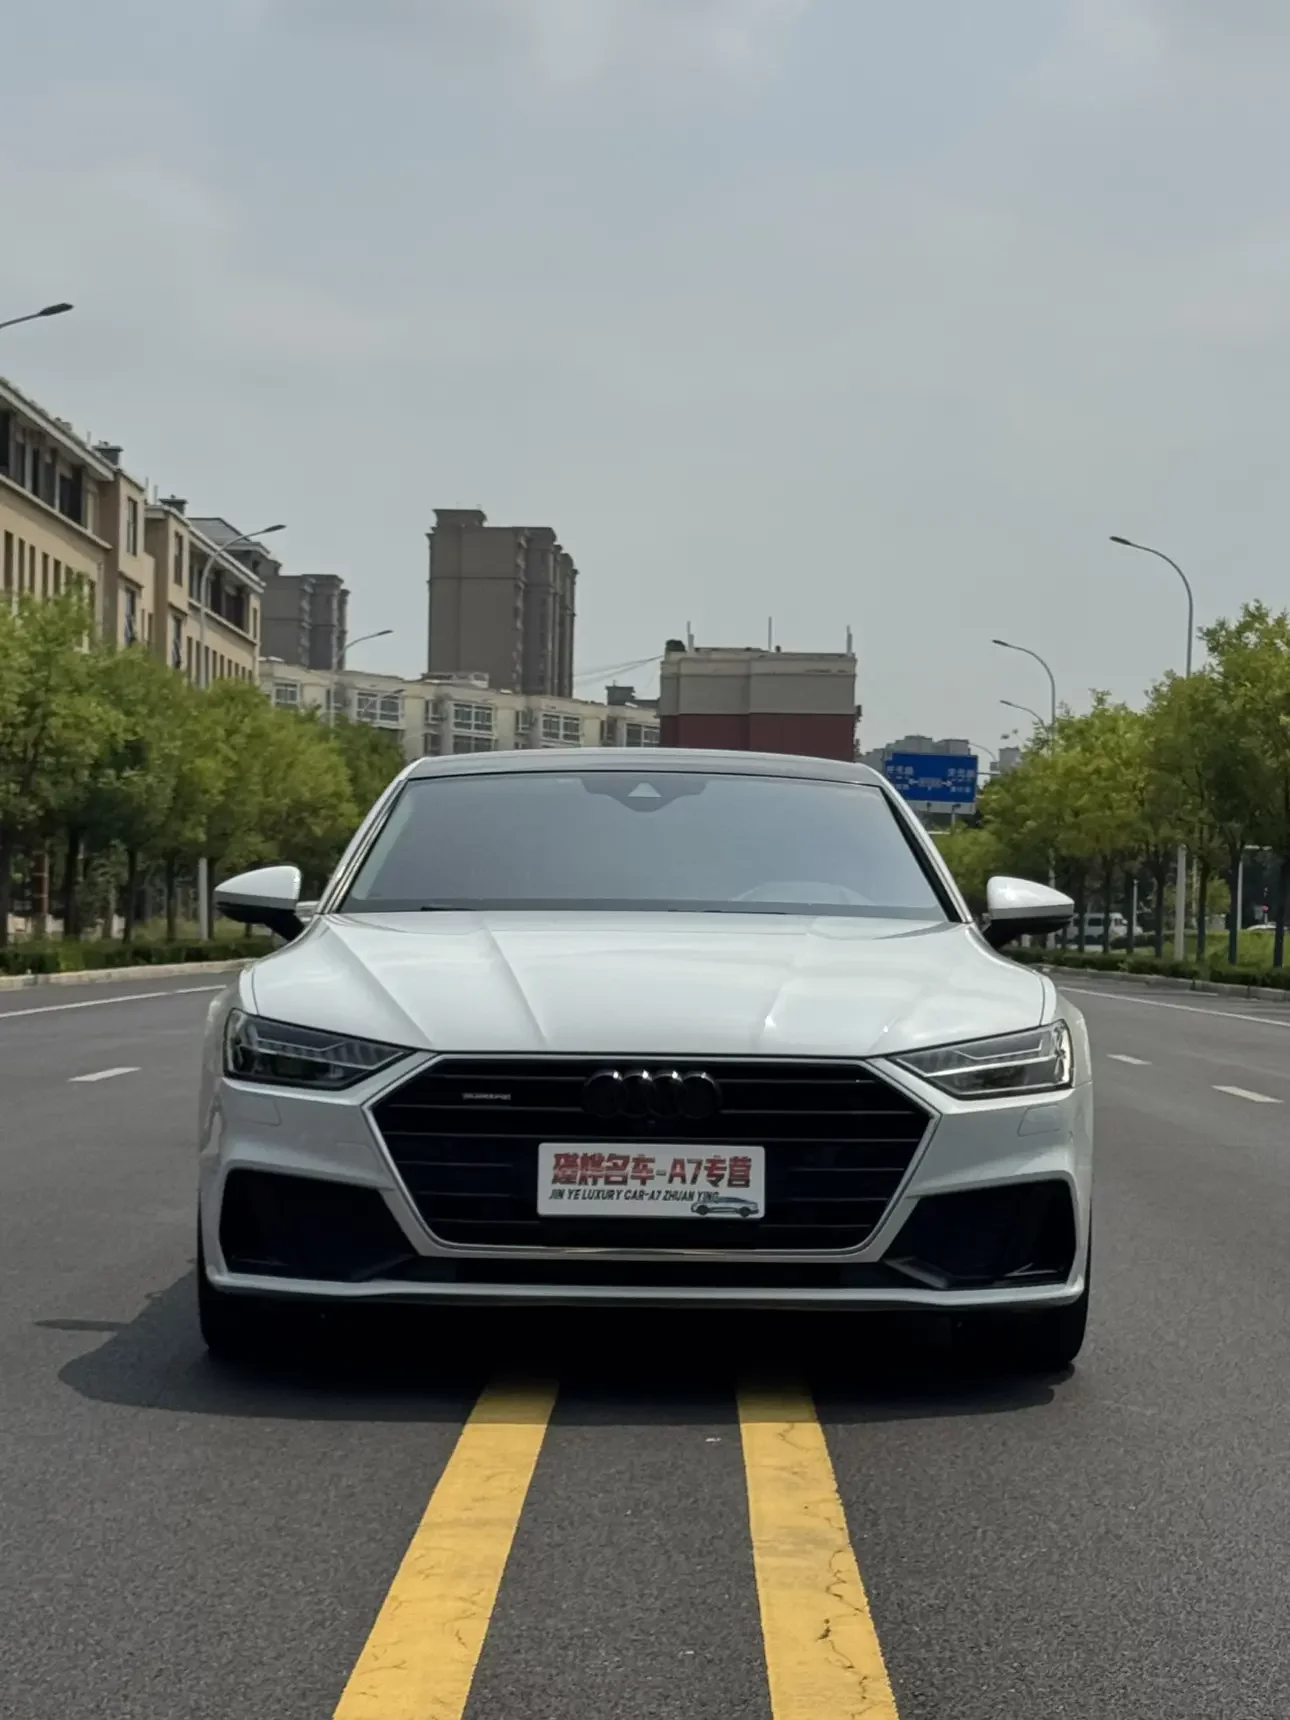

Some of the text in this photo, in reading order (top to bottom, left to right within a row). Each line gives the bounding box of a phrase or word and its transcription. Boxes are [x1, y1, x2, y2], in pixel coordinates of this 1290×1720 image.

[549, 1189, 564, 1200] JIN
[568, 1189, 581, 1200] YE
[581, 1189, 623, 1201] LUXURY
[624, 1189, 661, 1201] CAR-A7
[662, 1190, 694, 1201] ZHUAN
